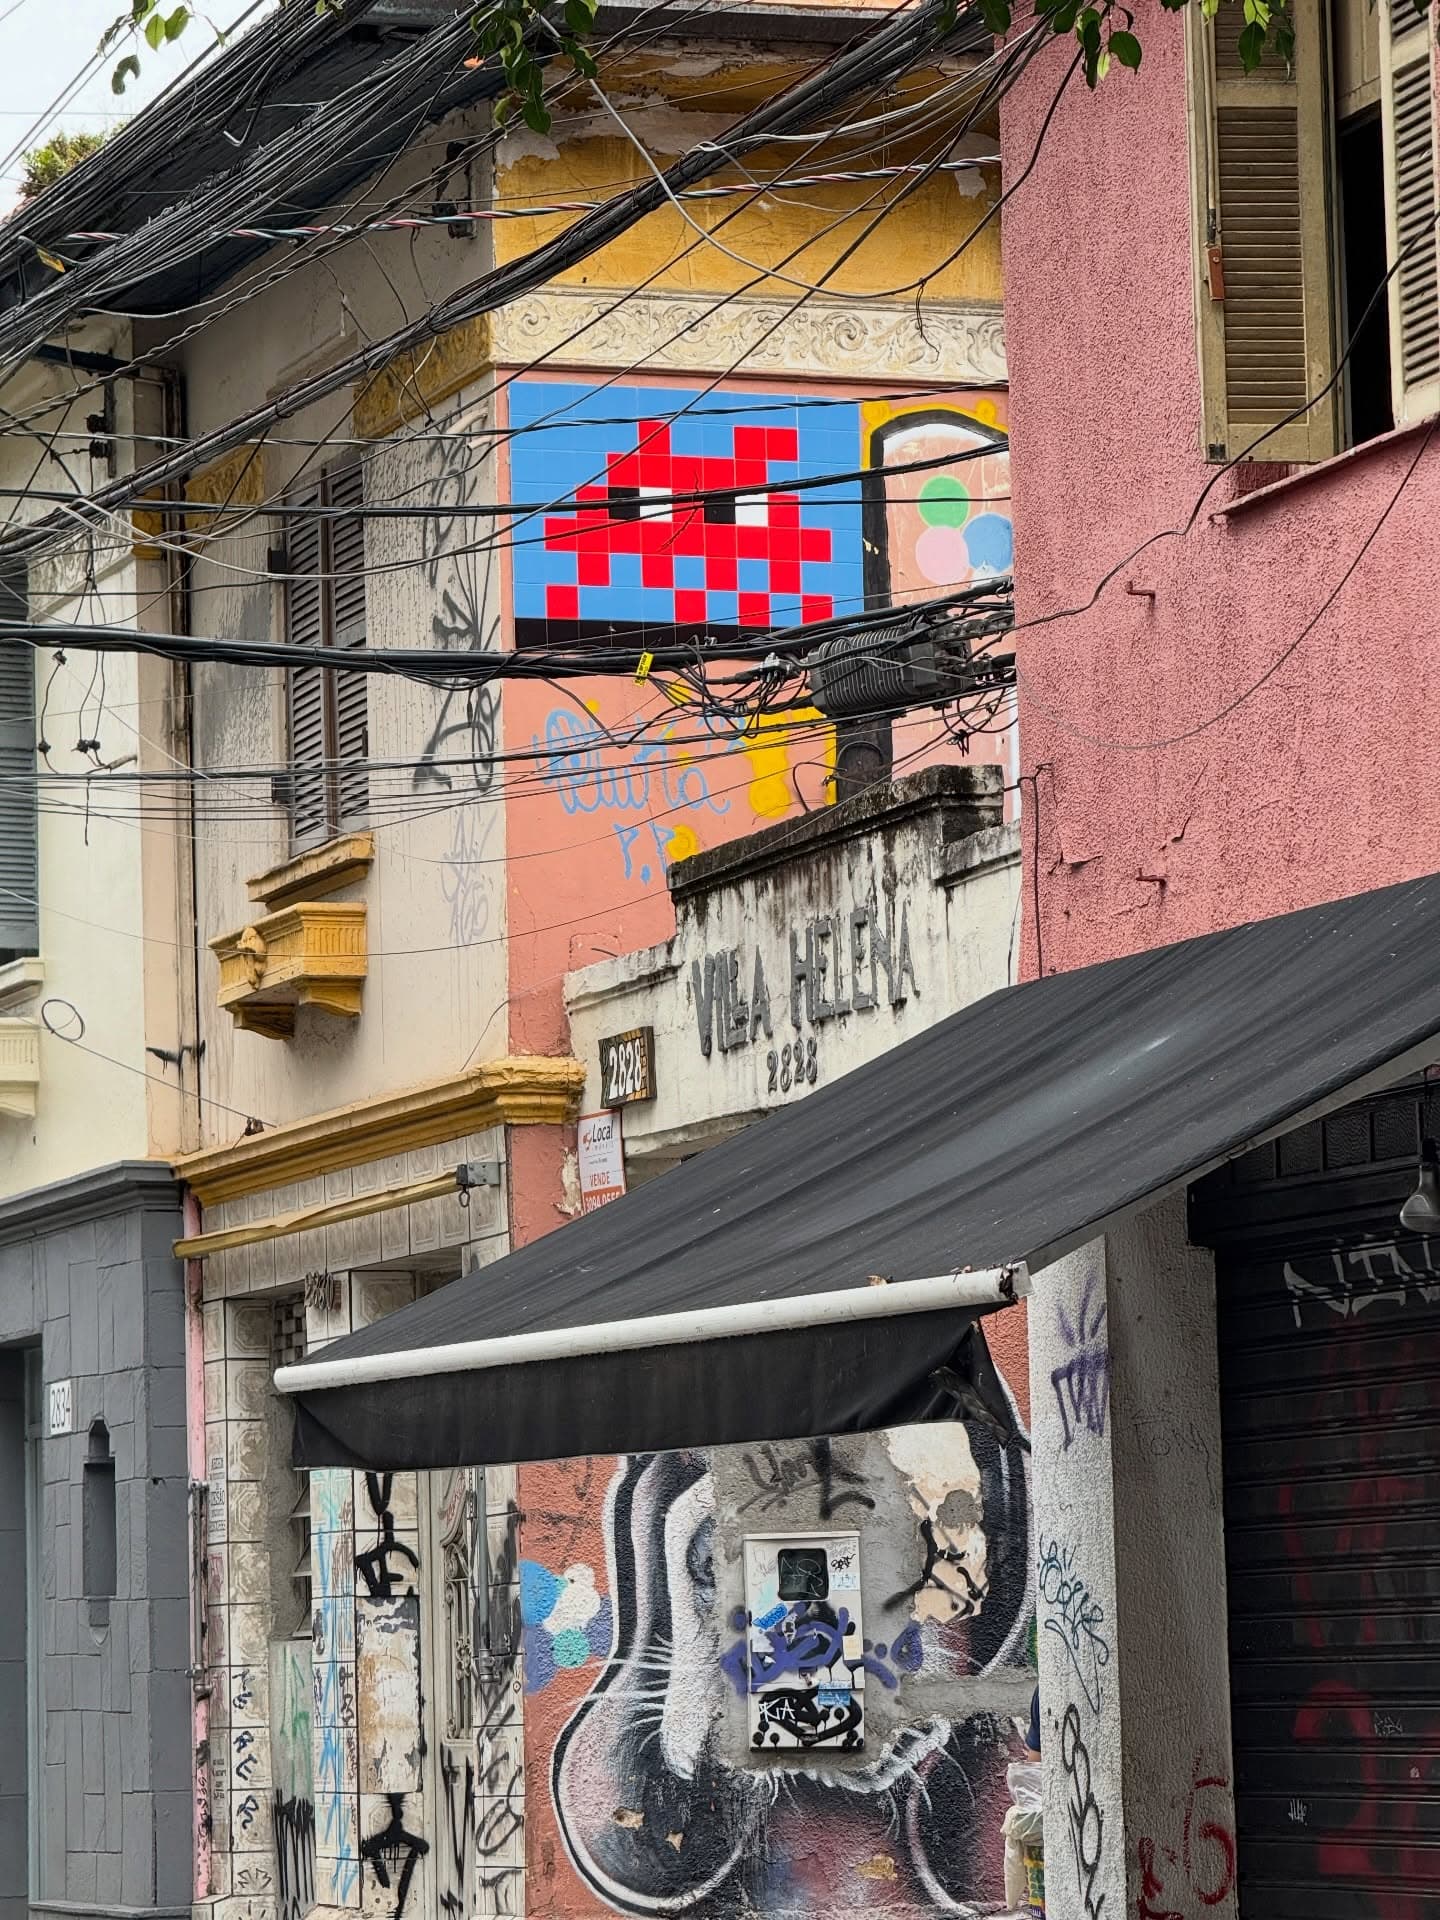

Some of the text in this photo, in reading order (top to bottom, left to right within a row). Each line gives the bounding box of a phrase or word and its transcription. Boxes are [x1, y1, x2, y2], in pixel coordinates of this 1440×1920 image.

[789, 899, 921, 1028] HELENA
[608, 1038, 642, 1100] 2828
[766, 1038, 818, 1093] 2828
[592, 1119, 614, 1143] Local
[589, 1170, 611, 1188] VENDE
